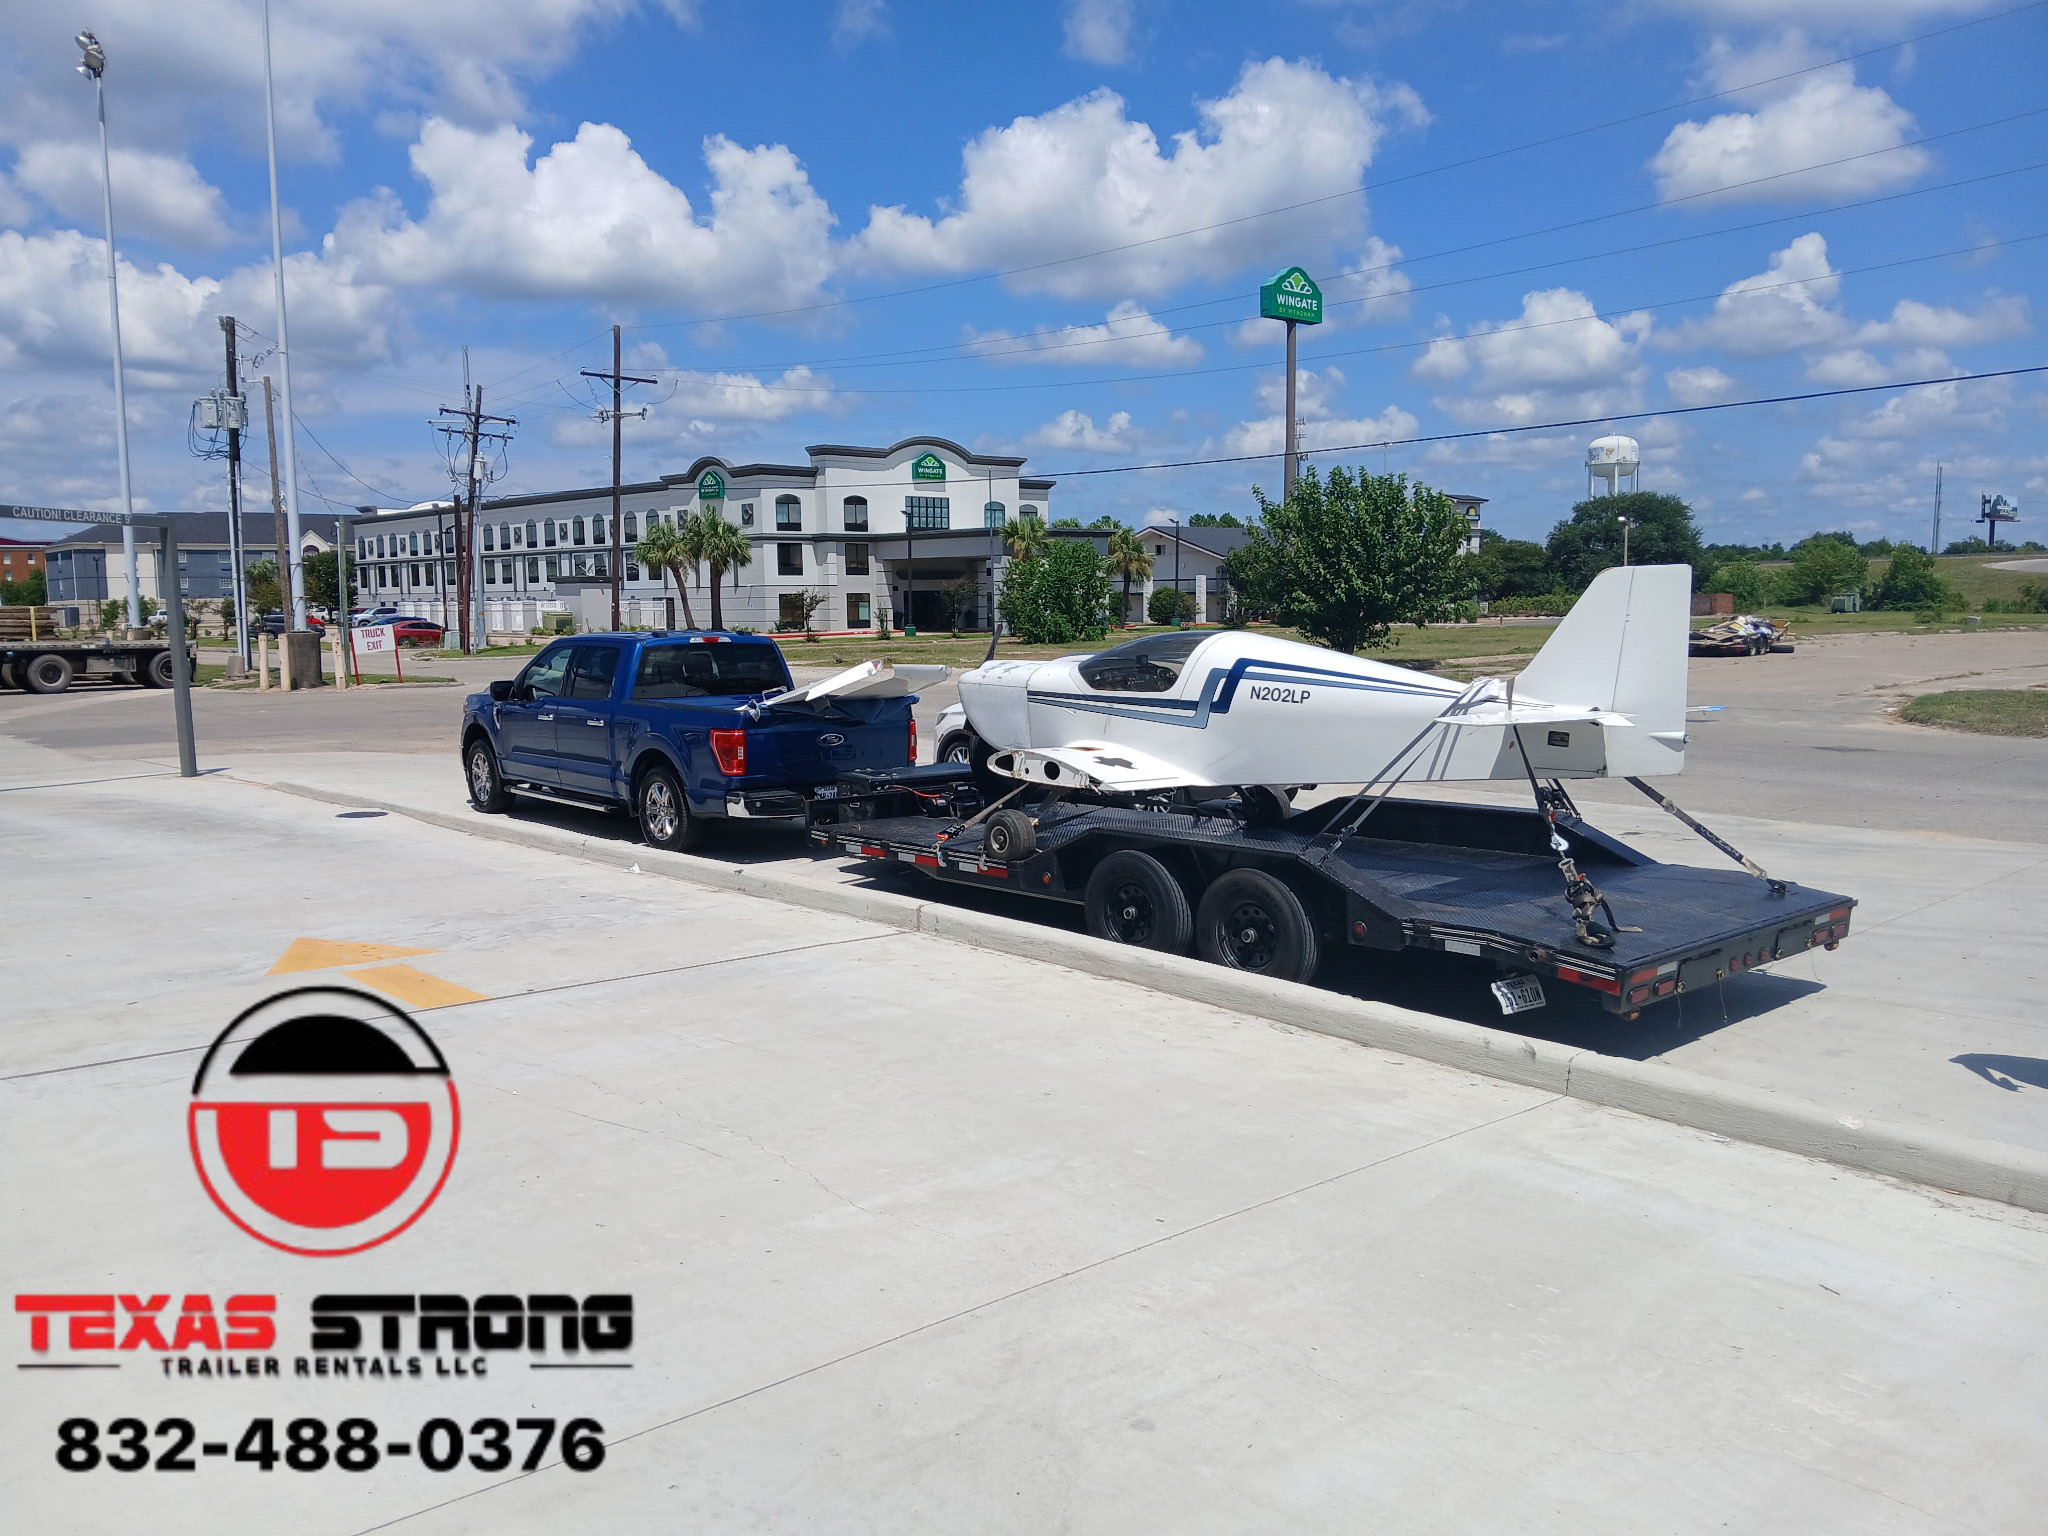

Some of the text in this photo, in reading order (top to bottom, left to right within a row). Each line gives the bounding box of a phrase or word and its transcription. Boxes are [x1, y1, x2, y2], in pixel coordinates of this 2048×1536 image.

[1276, 293, 1318, 311] WINGATE
[917, 466, 943, 475] WINGATE
[12, 506, 61, 520] CAUTION!
[63, 510, 122, 524] CLEARANCE
[360, 627, 385, 639] TRUCK
[366, 640, 382, 651] EXIT
[1249, 685, 1311, 704] N202LP
[1700, 825, 1740, 857] VULCAN
